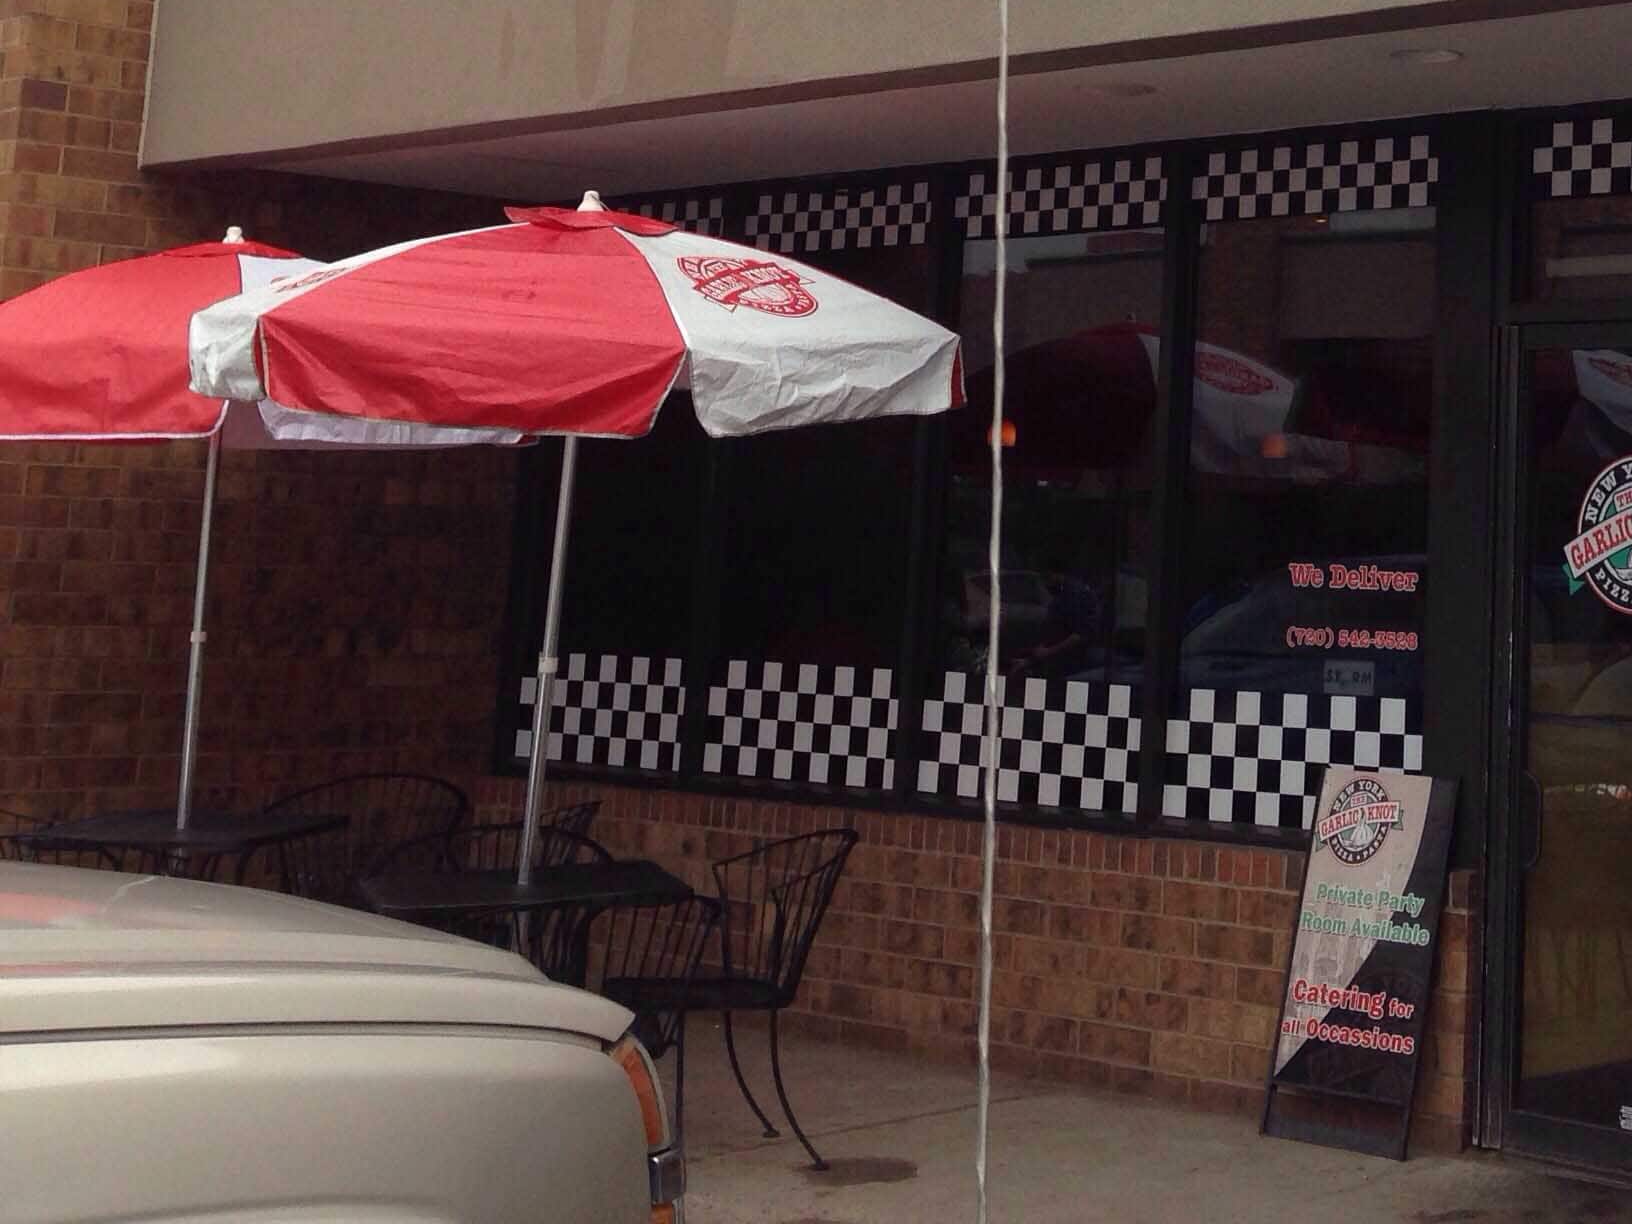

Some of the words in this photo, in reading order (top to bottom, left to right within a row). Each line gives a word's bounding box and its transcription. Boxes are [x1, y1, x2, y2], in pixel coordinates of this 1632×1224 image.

[1585, 471, 1618, 524] NEW
[1288, 563, 1324, 588] We
[1329, 565, 1418, 592] Deliver
[1286, 626, 1335, 649] (720)
[1358, 780, 1385, 801] YORK
[1321, 809, 1359, 836] GARLIC
[1367, 805, 1397, 821] KNOT
[1316, 883, 1373, 907] Private
[1377, 890, 1425, 918] Party
[1301, 911, 1346, 934] Room
[1350, 918, 1430, 946] Available
[1293, 978, 1386, 1019] Catering
[1389, 998, 1414, 1018] for
[1281, 1015, 1300, 1036] all
[1306, 1017, 1415, 1055] Occassions
